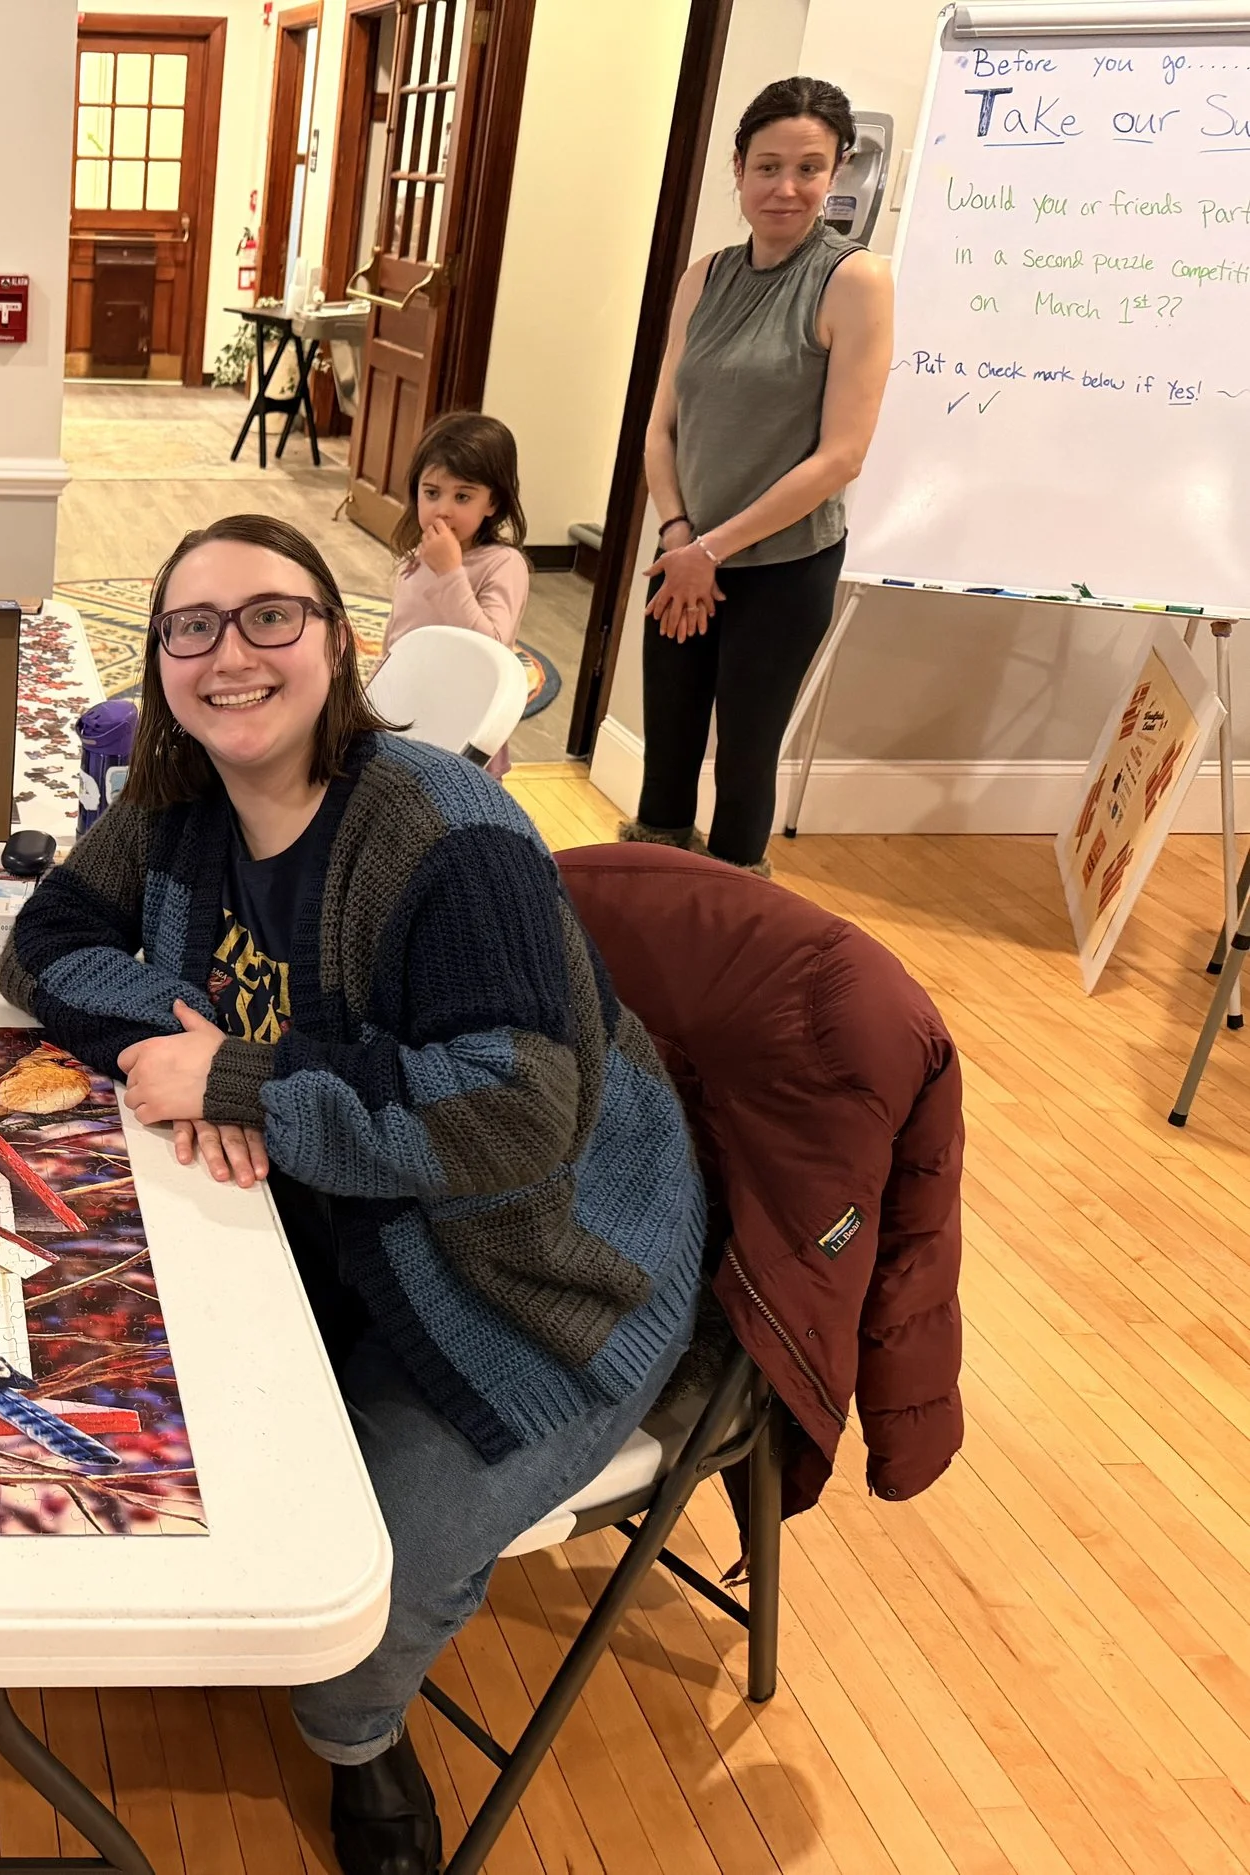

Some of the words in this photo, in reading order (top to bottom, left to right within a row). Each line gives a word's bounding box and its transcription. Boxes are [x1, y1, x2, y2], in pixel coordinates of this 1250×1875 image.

[973, 48, 1058, 77] Before
[1093, 55, 1134, 77] you
[964, 87, 1084, 138] Take
[1112, 109, 1181, 134] our
[947, 176, 1016, 211] Would
[1032, 194, 1068, 223] you
[1080, 200, 1102, 216] or
[1109, 190, 1183, 216] friends
[955, 235, 973, 265] in
[994, 249, 1008, 265] a
[1035, 291, 1100, 320] March
[912, 350, 946, 375] Put
[954, 362, 967, 376] a
[1033, 366, 1074, 383] mark
[1082, 366, 1126, 391] below
[1136, 376, 1155, 394] if
